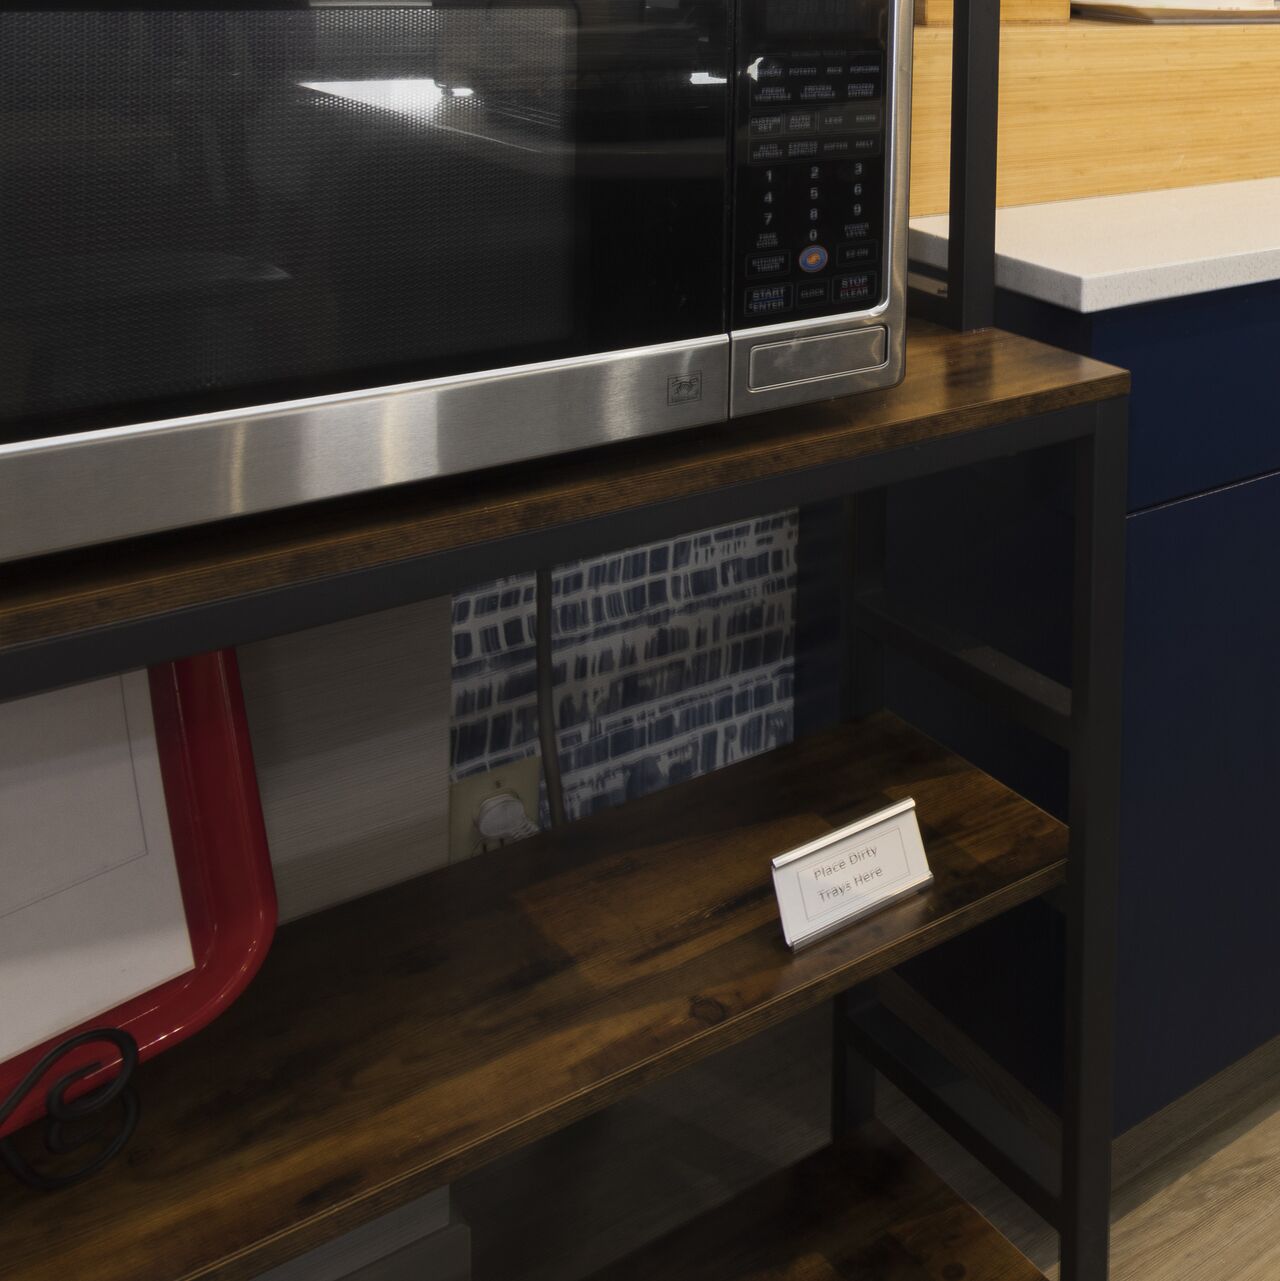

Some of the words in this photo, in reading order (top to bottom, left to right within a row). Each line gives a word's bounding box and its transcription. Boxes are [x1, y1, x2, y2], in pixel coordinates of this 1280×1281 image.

[841, 275, 868, 288] STOP
[752, 288, 785, 301] START
[814, 858, 846, 881] Place
[849, 846, 878, 865] Dirty
[817, 880, 852, 902] Trays
[854, 866, 883, 887] Here
